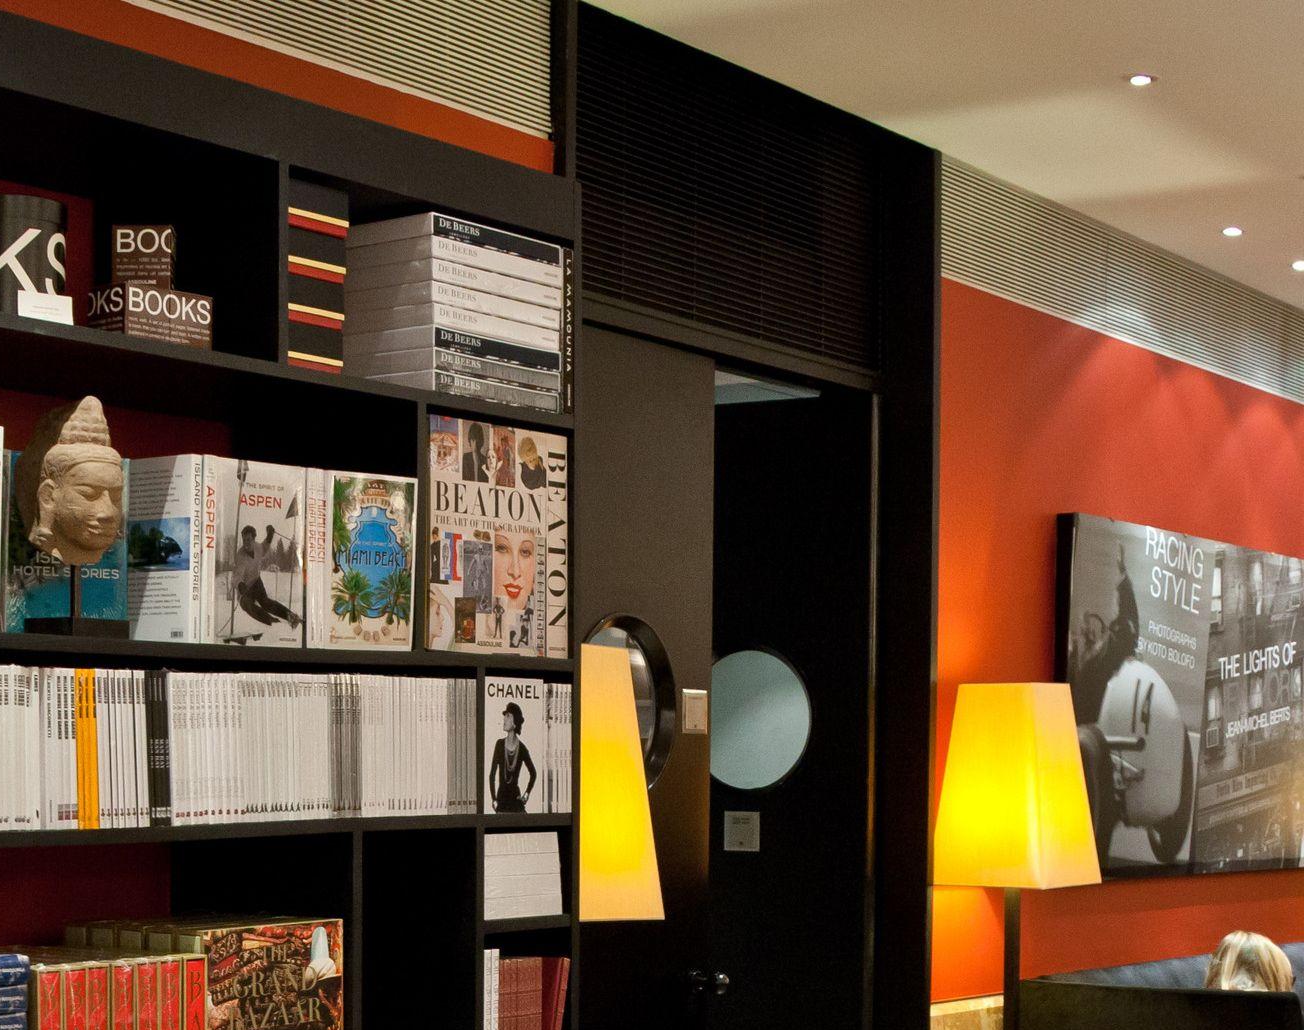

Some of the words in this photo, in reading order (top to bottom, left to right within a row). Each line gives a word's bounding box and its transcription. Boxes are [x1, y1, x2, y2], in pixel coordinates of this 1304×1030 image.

[127, 285, 212, 326] BOOKS
[440, 330, 453, 341] DE
[454, 333, 482, 348] BEERS
[192, 463, 201, 507] ISLAND
[239, 493, 282, 510] ASPEN
[435, 480, 543, 524] BEATON
[192, 511, 201, 549] HOTEL
[205, 485, 216, 550] ASPEN
[435, 514, 451, 525] THE
[453, 516, 467, 528] ART
[467, 518, 479, 529] OF
[497, 522, 543, 536] SCRAPBOOK
[338, 549, 373, 568] MIAMI
[374, 550, 407, 569] BEACH
[547, 451, 567, 628] BEATON
[1145, 525, 1204, 579] RACING
[13, 566, 60, 577] HOTEL
[192, 551, 200, 601] STORIES
[1150, 565, 1200, 615] STYLE
[1218, 653, 1241, 681] THE
[1243, 646, 1281, 676] LIGHTS
[1282, 640, 1298, 667] OF
[487, 682, 540, 701] CHANEL
[232, 965, 318, 999] GRAND
